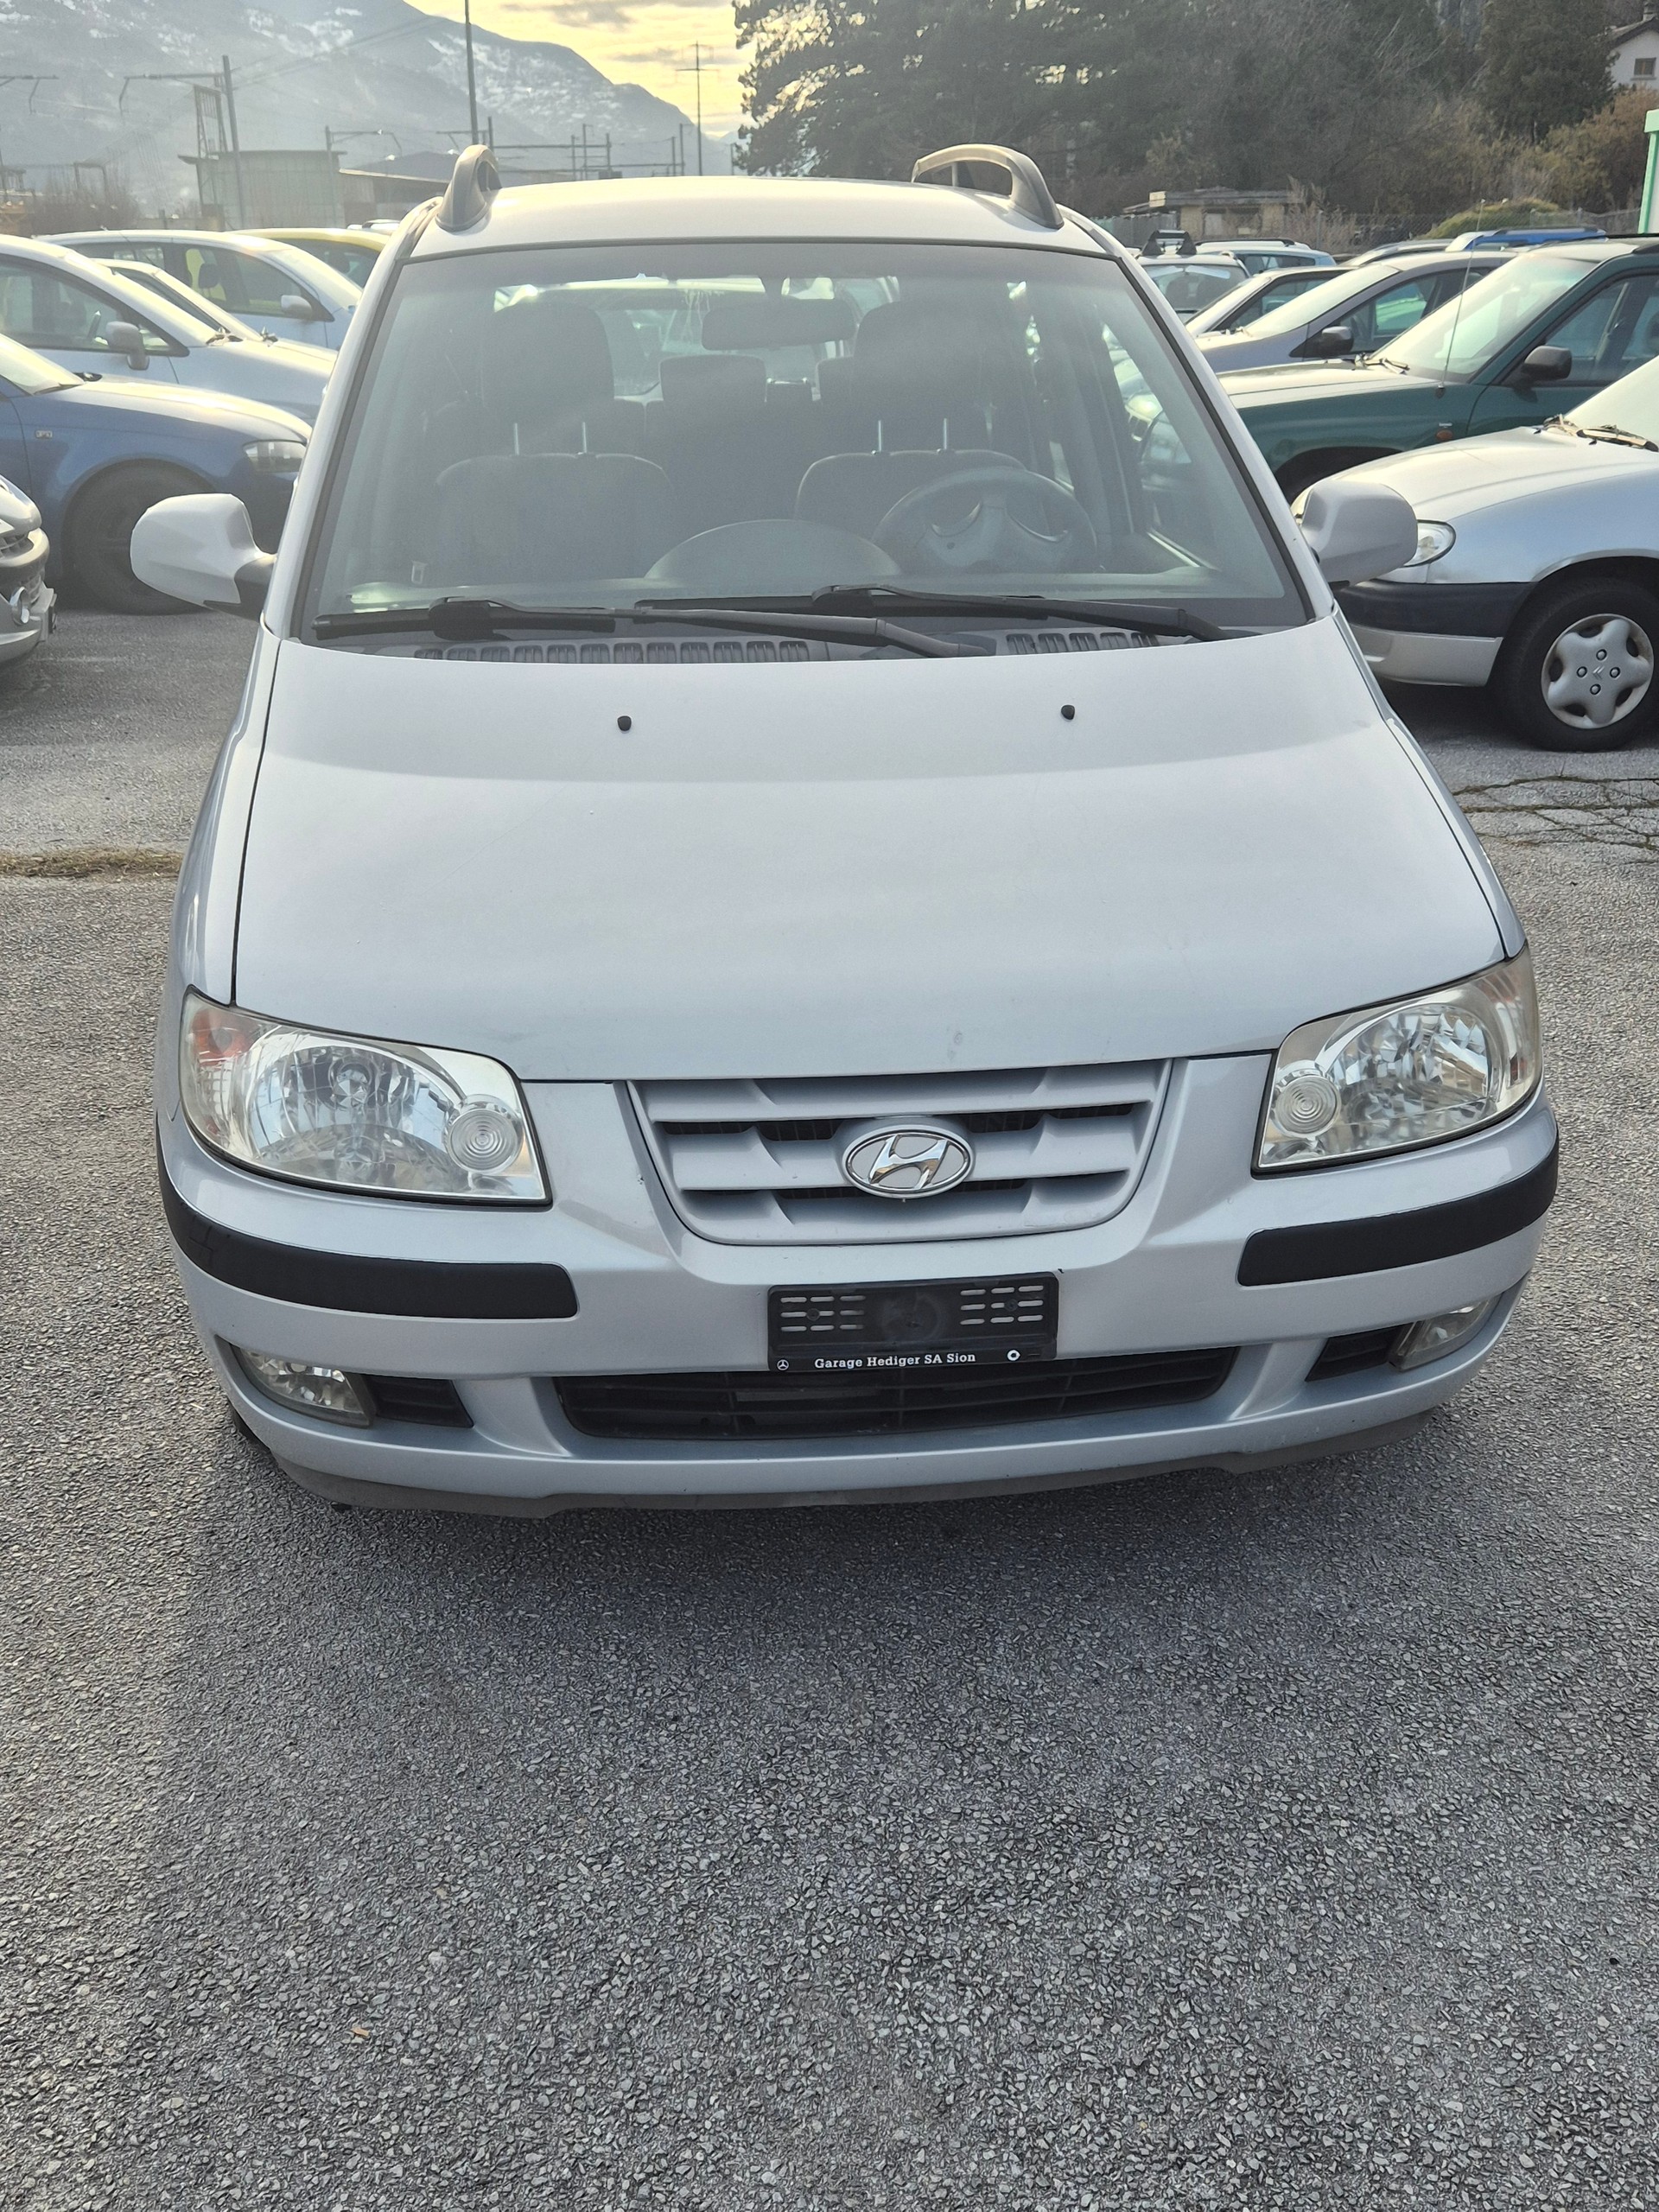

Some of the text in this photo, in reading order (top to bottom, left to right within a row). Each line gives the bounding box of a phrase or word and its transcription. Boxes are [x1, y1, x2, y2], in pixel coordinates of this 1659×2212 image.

[814, 1352, 976, 1370] Garage Hediger SA Sion
